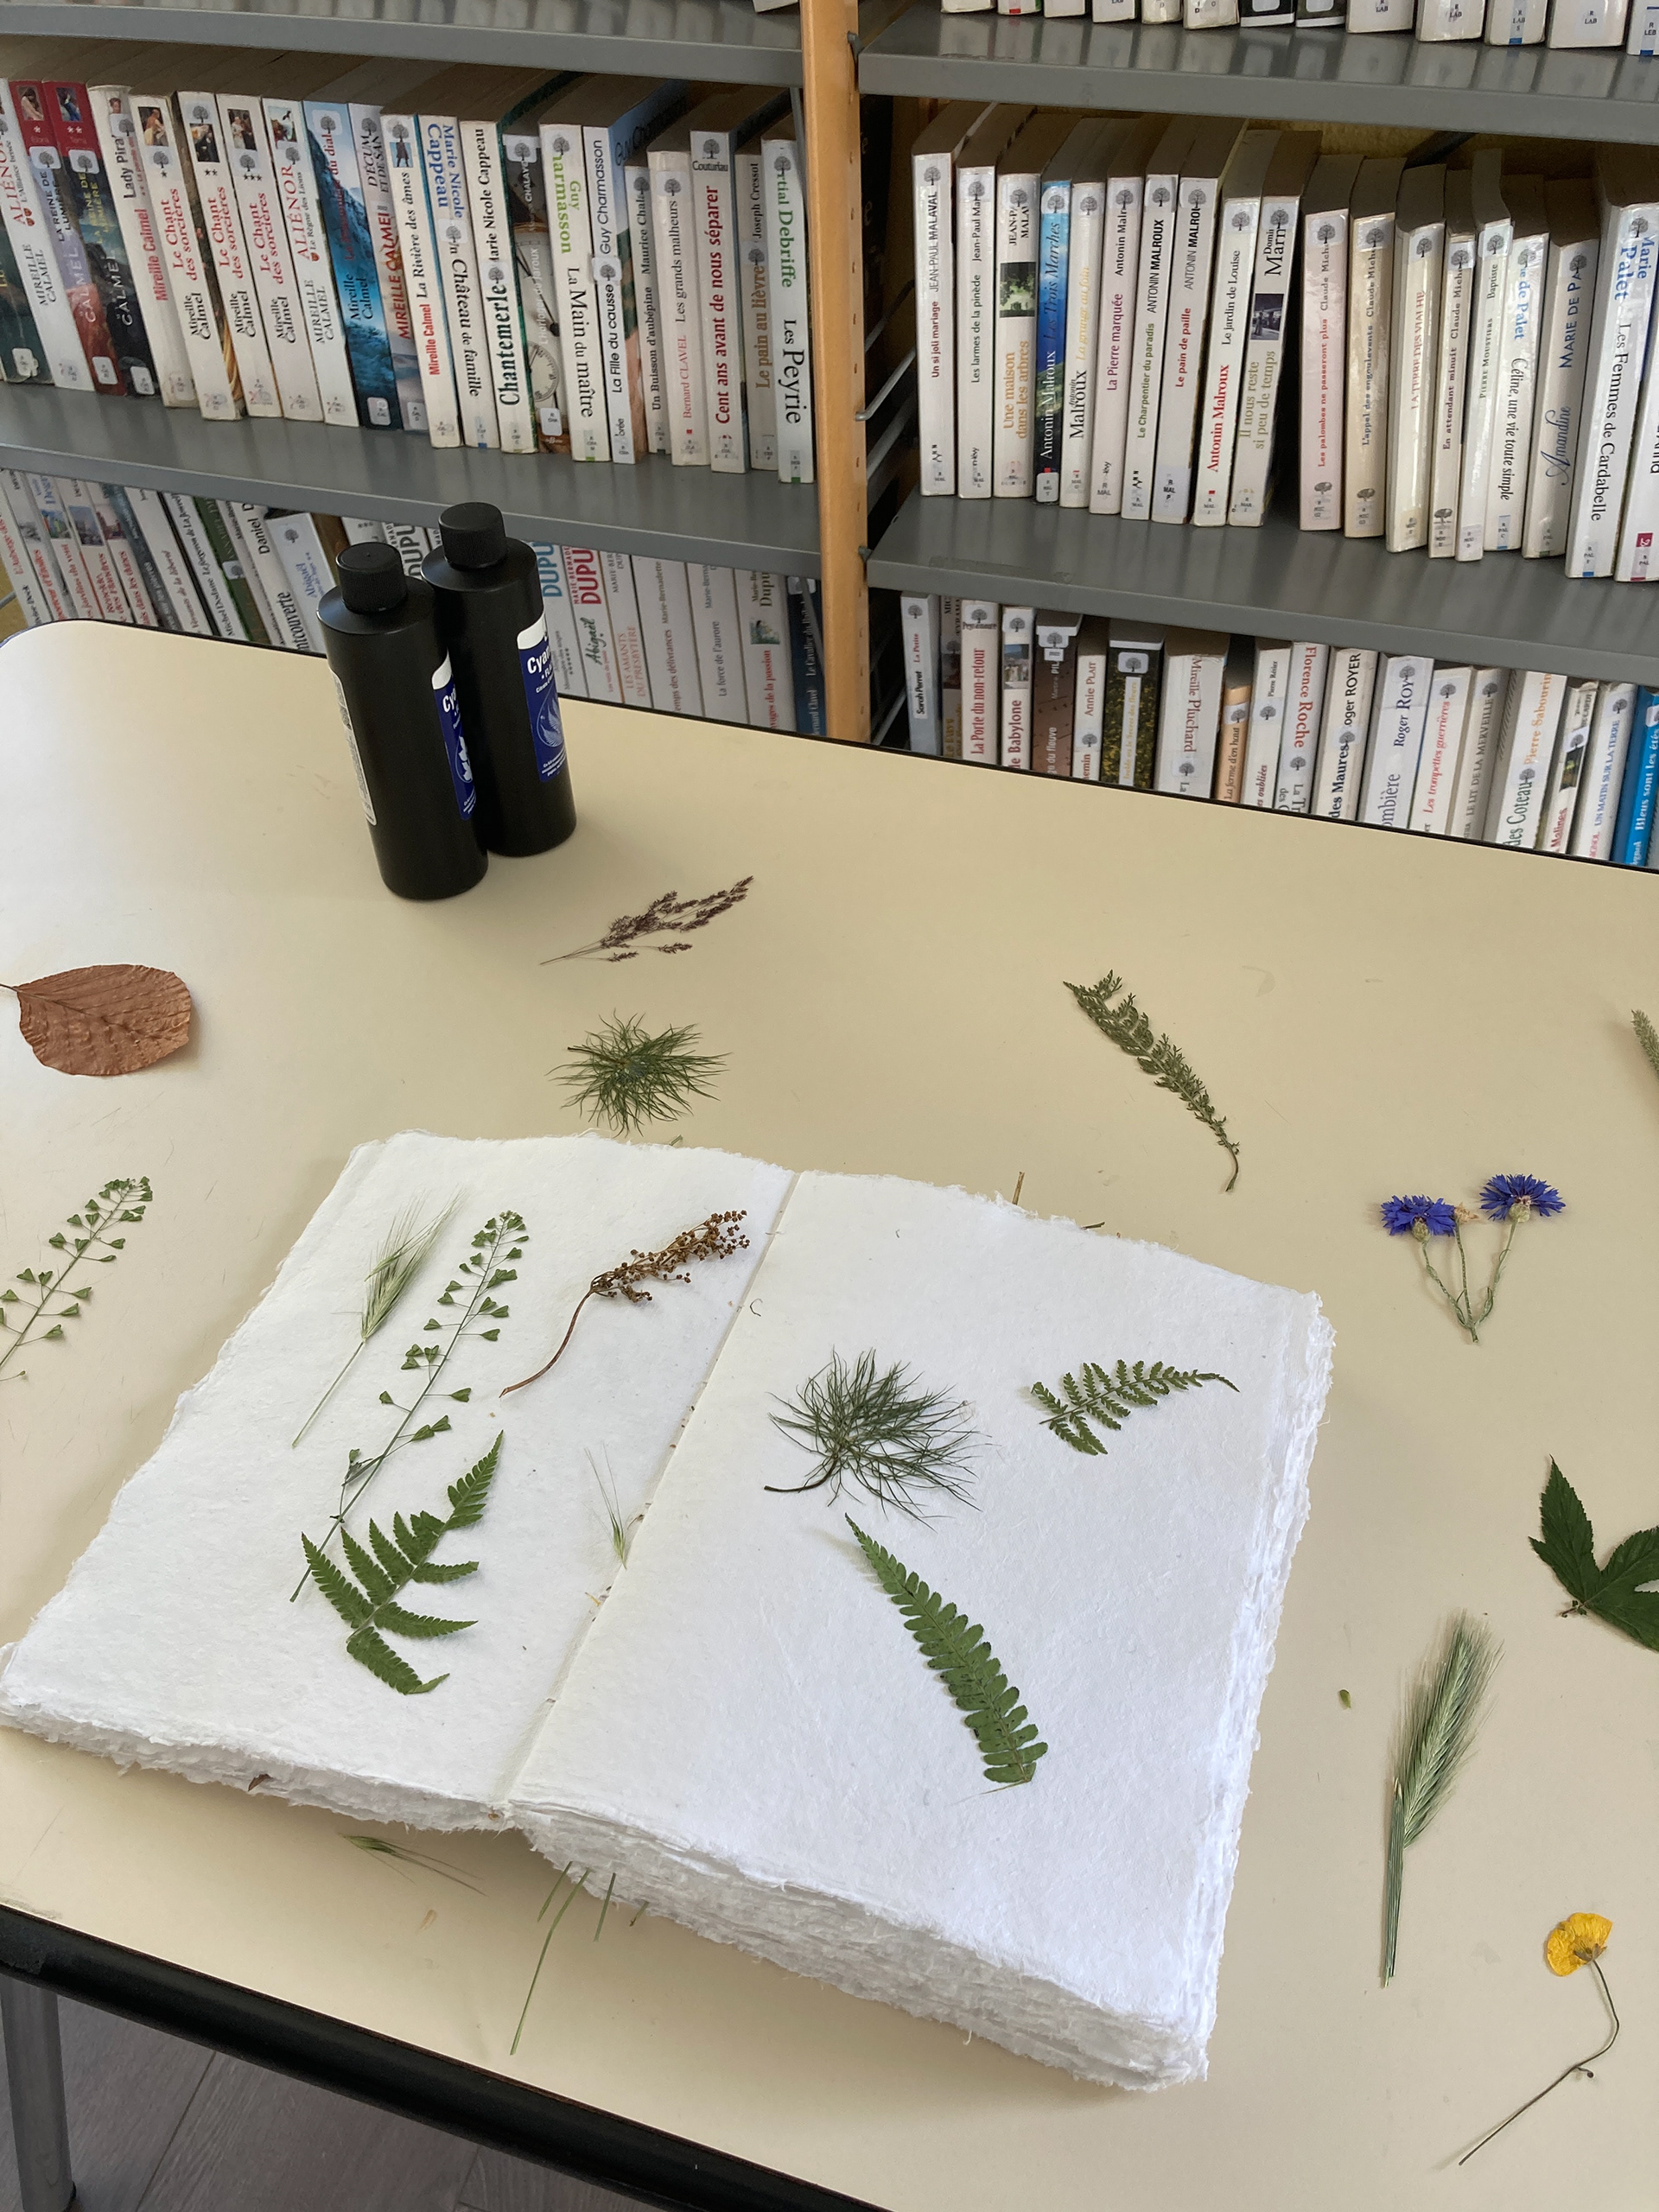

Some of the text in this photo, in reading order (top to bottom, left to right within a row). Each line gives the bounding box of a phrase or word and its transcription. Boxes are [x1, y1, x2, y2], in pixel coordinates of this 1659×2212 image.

[118, 167, 136, 199] Lady
[427, 124, 448, 207] Cappeau
[442, 124, 463, 219] Marie Nicole
[474, 129, 496, 229] Nicole Cappeau
[592, 140, 612, 254] Guy Charmasson
[161, 199, 184, 268] Le Chant
[281, 165, 309, 261] ALIÉNOR
[749, 162, 763, 238] Joseph Cressot
[135, 208, 168, 302] Mireille Calmel
[169, 188, 197, 282] des sorcières
[399, 172, 428, 299] La Rivière des âmes
[666, 200, 686, 322] Les grands malheurs
[779, 211, 793, 288] Debriffe
[927, 192, 938, 292] JEAN-PAUL MALAVAL
[971, 219, 982, 262] Jean-Paul
[1046, 222, 1059, 278] Marches
[1115, 237, 1126, 276] Antonin
[1147, 219, 1164, 313] ANTONIN MALROUX
[22, 244, 48, 306] MIREILLE
[35, 249, 57, 302] CALMEL
[344, 274, 361, 321] Mireille
[357, 278, 373, 320] Calmel
[704, 185, 730, 424] Cent ans avant de nous séparer
[971, 275, 983, 308] pinède
[1222, 251, 1241, 345] Le jardin de Louise
[1320, 276, 1329, 311] Claude
[1614, 245, 1637, 299] Palet
[185, 296, 200, 336] Mireille
[192, 292, 212, 340] Calmel
[304, 279, 325, 344] MIREILLE
[317, 286, 334, 340] CALMEL
[390, 276, 410, 340] MIREILLE
[420, 304, 440, 375] Mireille Calmel
[452, 259, 481, 397] Château de famille
[604, 284, 622, 393] La Fille du causse
[752, 265, 772, 389] Le pain au lièvre
[971, 322, 981, 334] de
[1319, 319, 1329, 340] plus
[488, 284, 520, 405] Chantemerle
[568, 268, 593, 417] La Main du maître
[778, 320, 806, 423] Les Peyrie
[971, 336, 981, 366] larmes
[971, 369, 981, 383] Les
[1107, 294, 1124, 391] La Pierre marquée
[1320, 343, 1329, 391] passeront
[1559, 321, 1576, 368] MARIE
[1040, 351, 1056, 460] Antonin Malroux
[1069, 371, 1087, 439] Malroux
[1137, 323, 1155, 438] Le Charpentier du paradis
[1507, 400, 1517, 419] une
[1207, 365, 1230, 473] Antonin Malroux
[1319, 408, 1328, 448] palombes
[1502, 440, 1515, 466] toute
[1503, 423, 1516, 436] vie
[1540, 406, 1570, 485] Amandine
[1591, 323, 1630, 521] Les Femmes de Cardabelle
[1500, 468, 1514, 500] simple
[247, 518, 270, 554] Daniel
[582, 548, 602, 605] DUPU
[971, 648, 984, 754] La Porte du non-retour
[1084, 689, 1095, 716] Annie
[1184, 658, 1202, 752] Mireille Pluchard
[1294, 646, 1316, 747] Florence Roche
[1346, 653, 1360, 696] ROYER
[1008, 700, 1024, 753] Babylone
[1394, 715, 1409, 747] Roger
[1524, 674, 1550, 765] Pierre Sabourin
[1329, 745, 1349, 818] des Maures
[1424, 798, 1435, 813] Les
